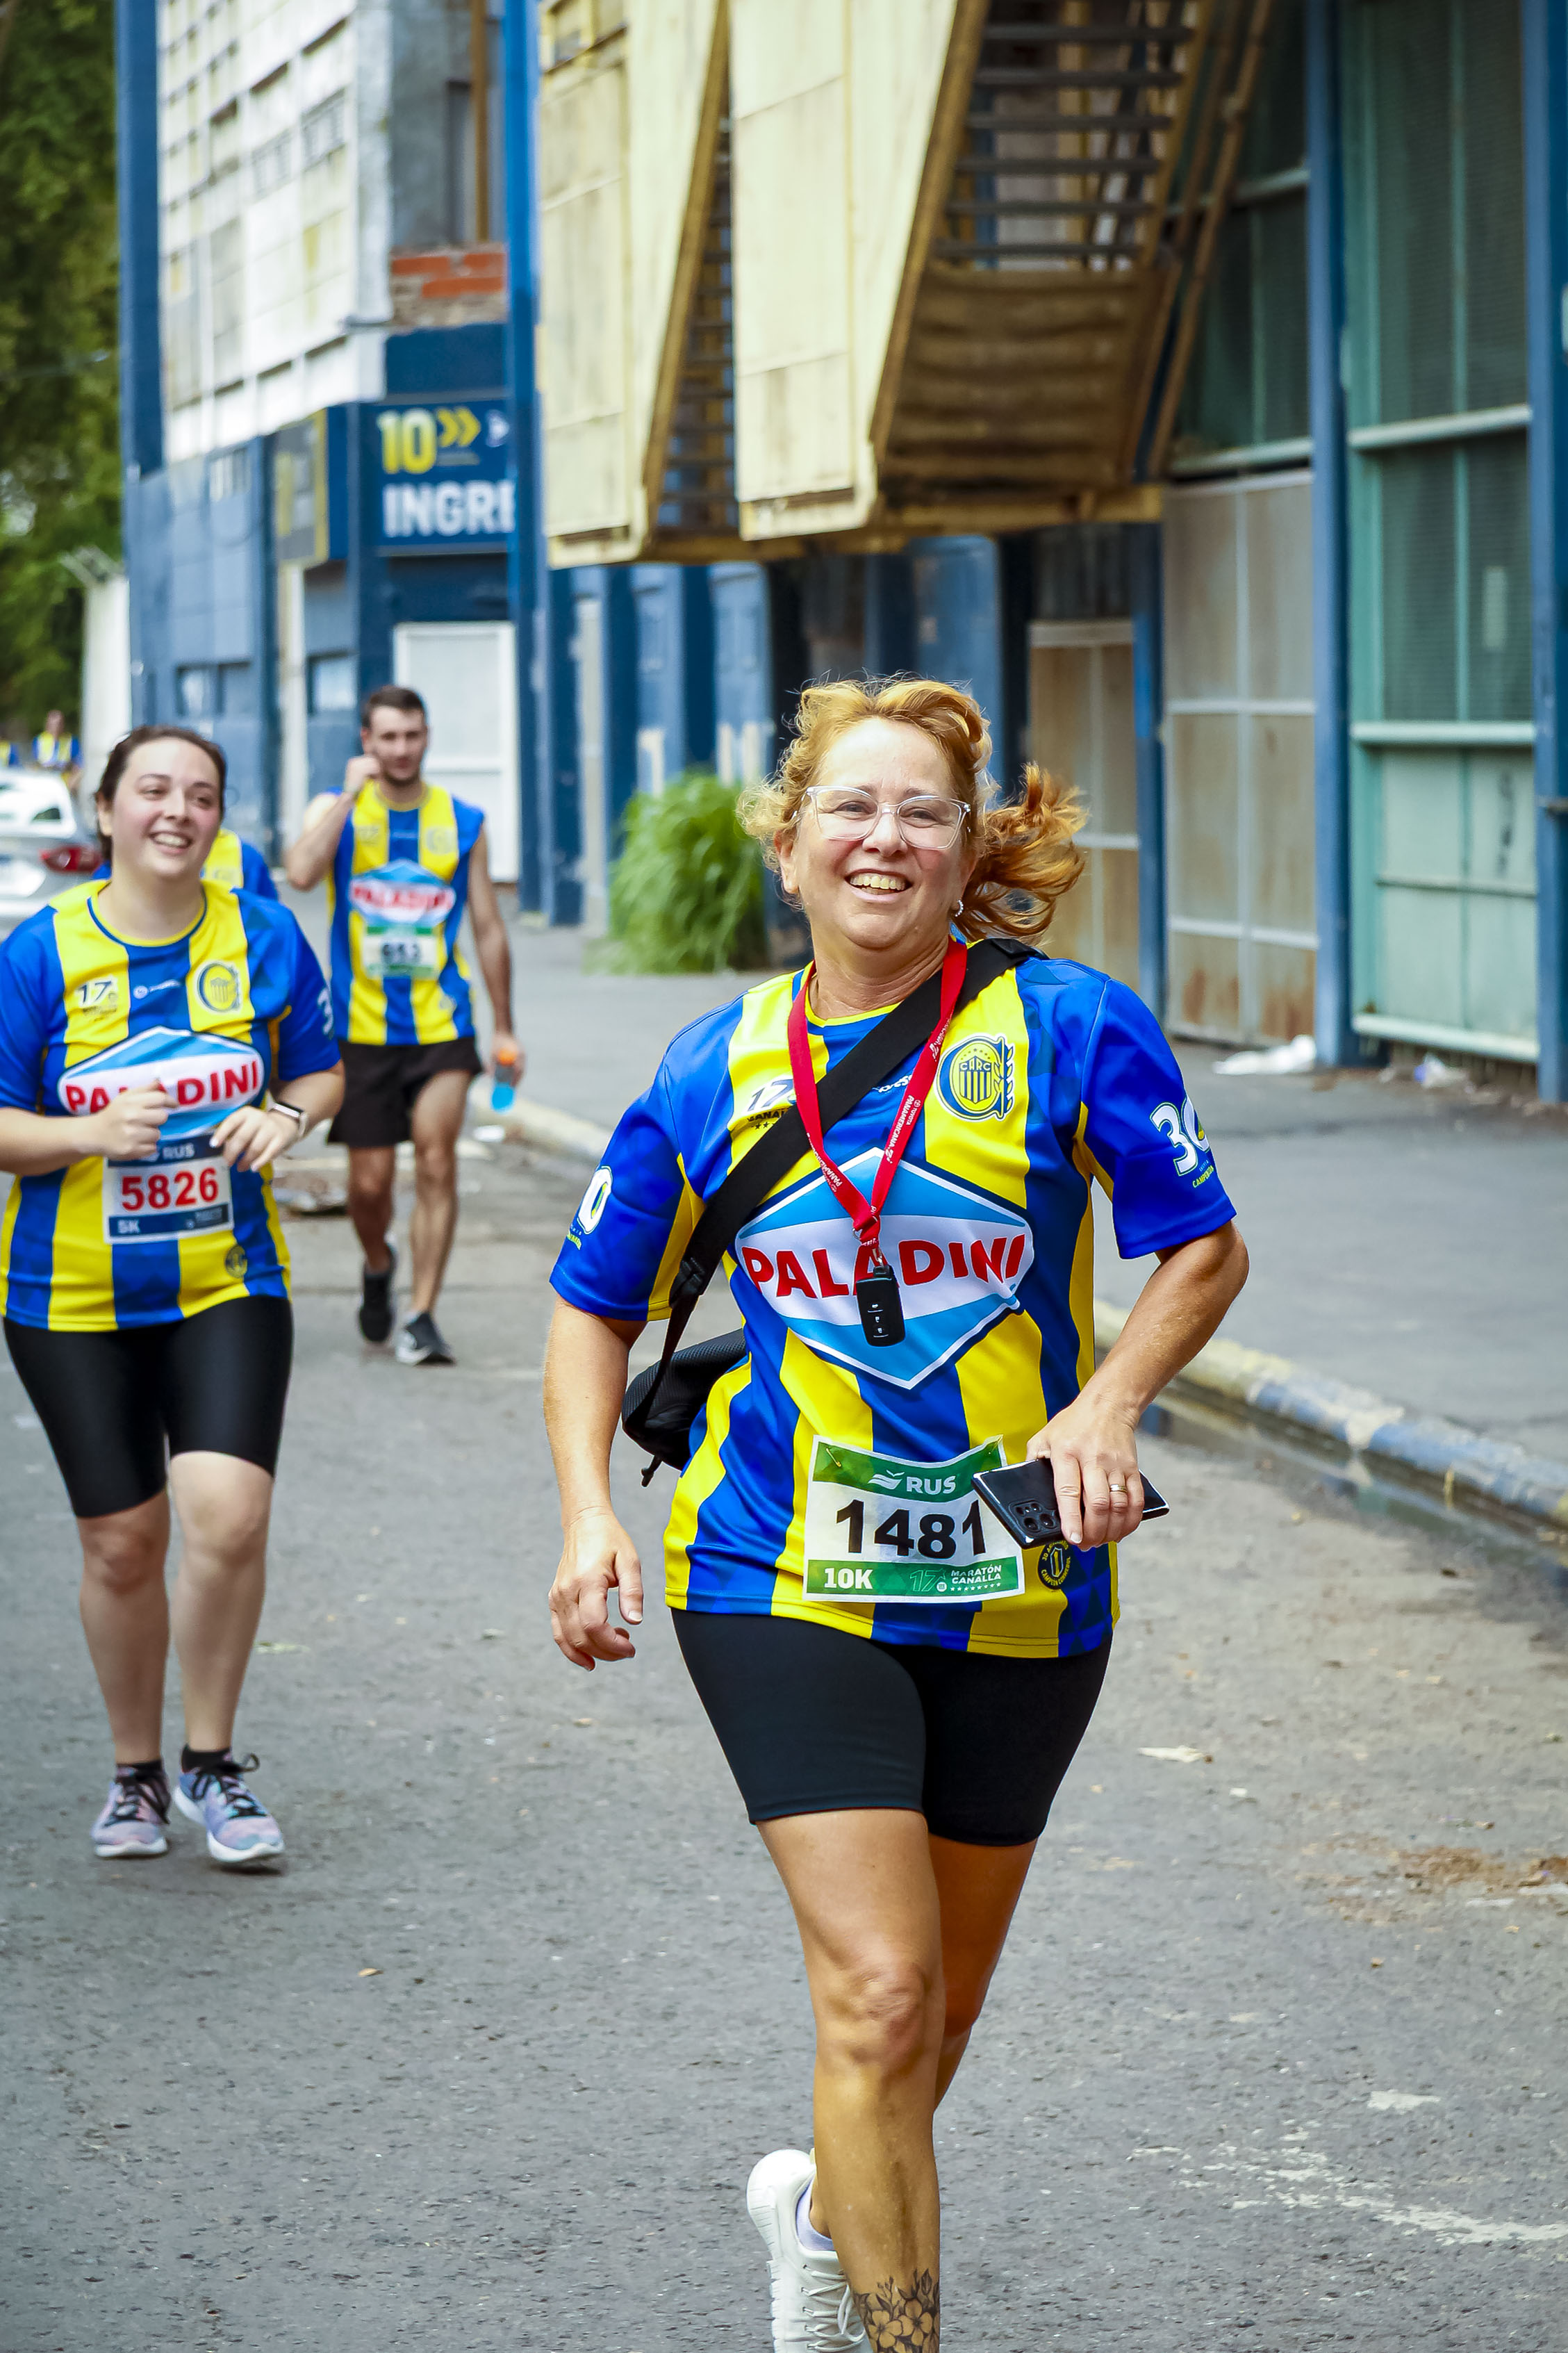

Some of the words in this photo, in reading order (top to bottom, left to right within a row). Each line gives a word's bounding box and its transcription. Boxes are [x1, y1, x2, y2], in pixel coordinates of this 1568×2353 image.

[377, 407, 436, 474] 10
[65, 1060, 259, 1114] PADINI
[889, 1094, 915, 1148] PANAMERICANA
[906, 1107, 918, 1126] TOYOTA
[162, 1143, 195, 1161] RUS
[121, 1167, 219, 1212] 5826
[907, 1475, 956, 1495] RUS
[836, 1499, 987, 1559] 1481
[824, 1567, 873, 1589] 10K
[950, 1564, 1002, 1577] MARATÓN
[951, 1573, 1002, 1584] CANALLA
